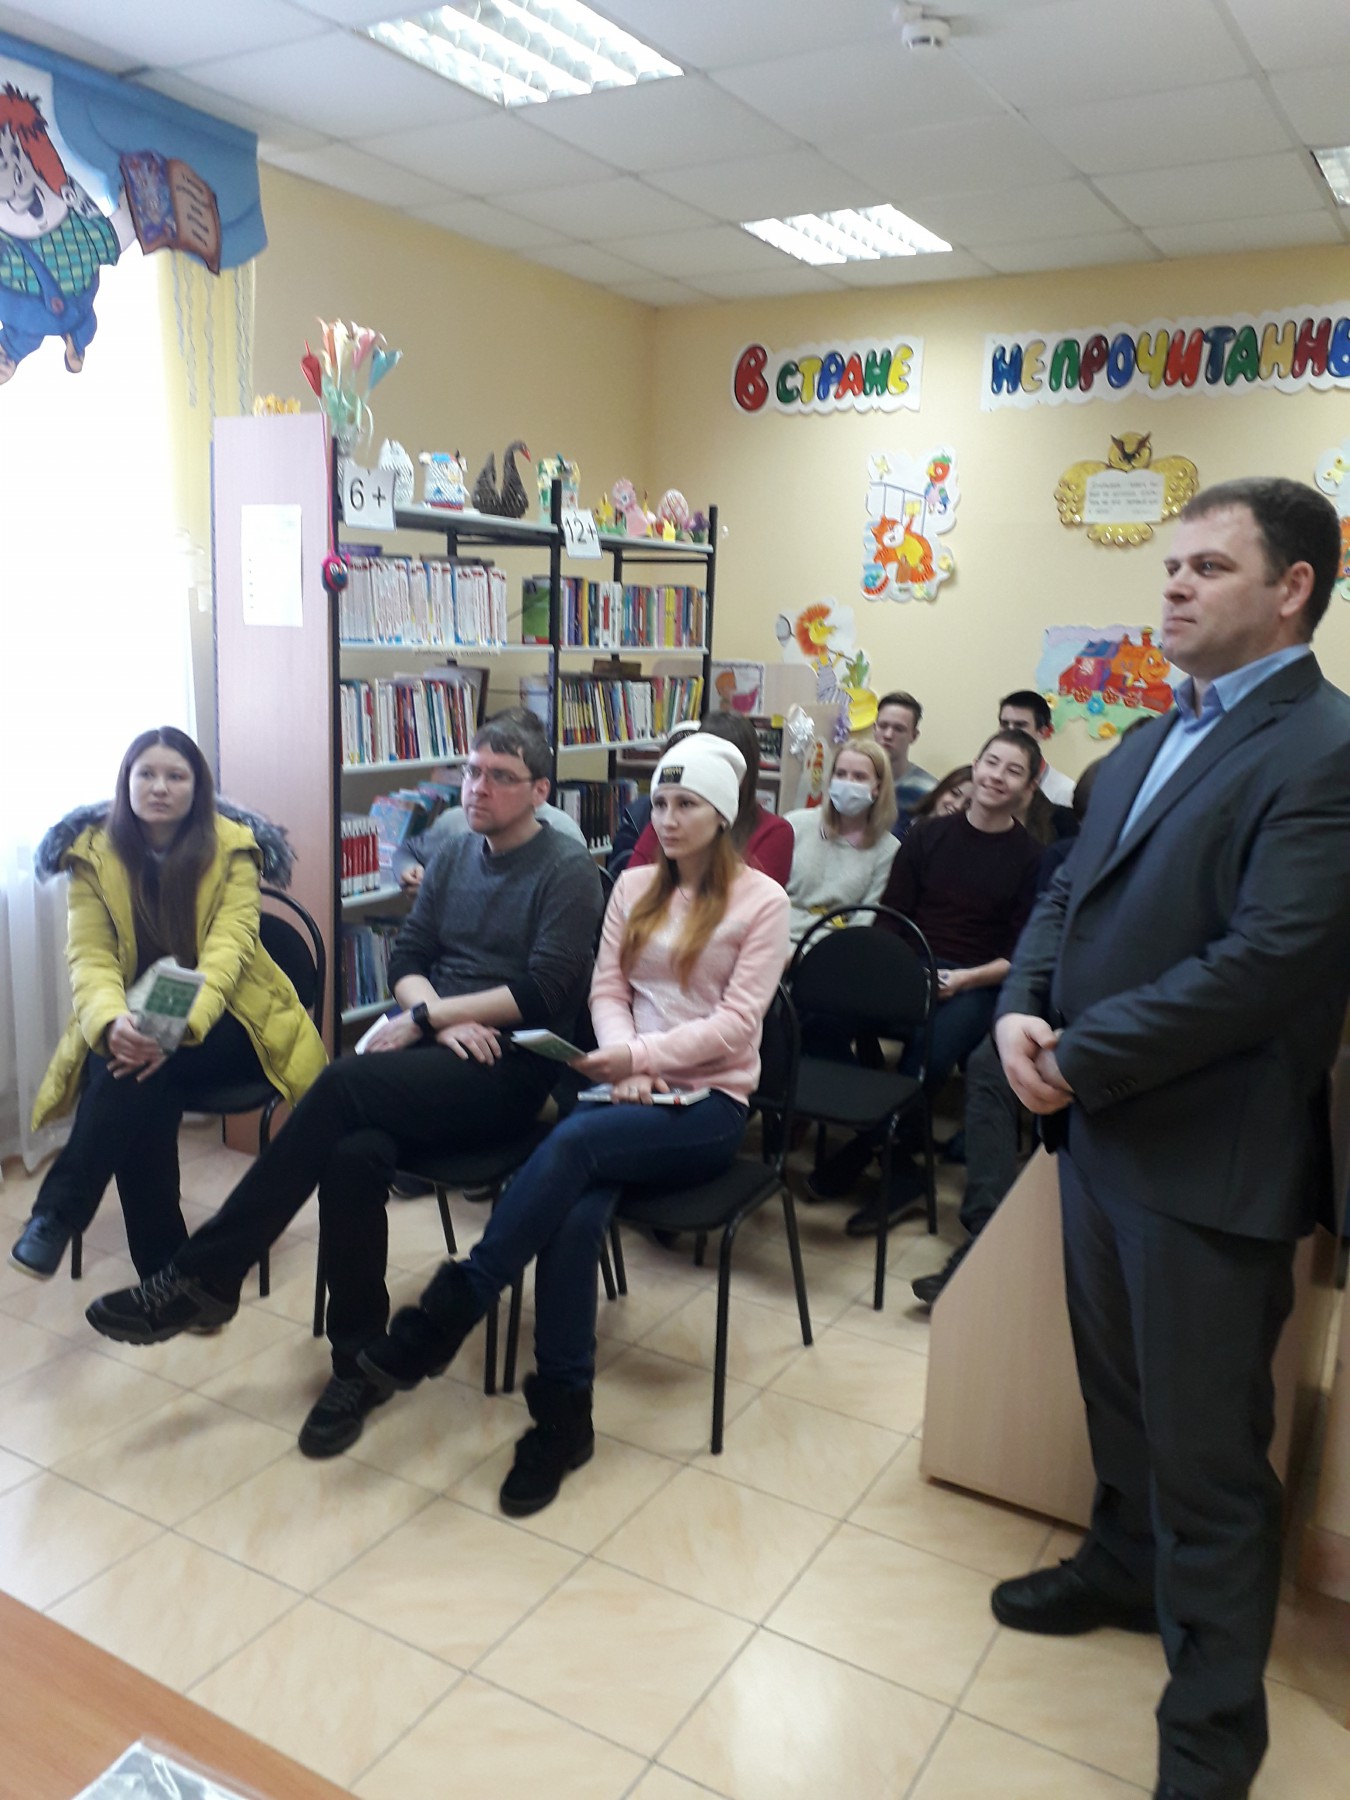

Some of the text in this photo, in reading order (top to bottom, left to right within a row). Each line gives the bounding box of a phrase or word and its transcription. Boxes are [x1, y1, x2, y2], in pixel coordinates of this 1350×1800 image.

[734, 343, 769, 411] В
[776, 343, 914, 404] СТРАНЕ
[565, 516, 596, 544] 12+
